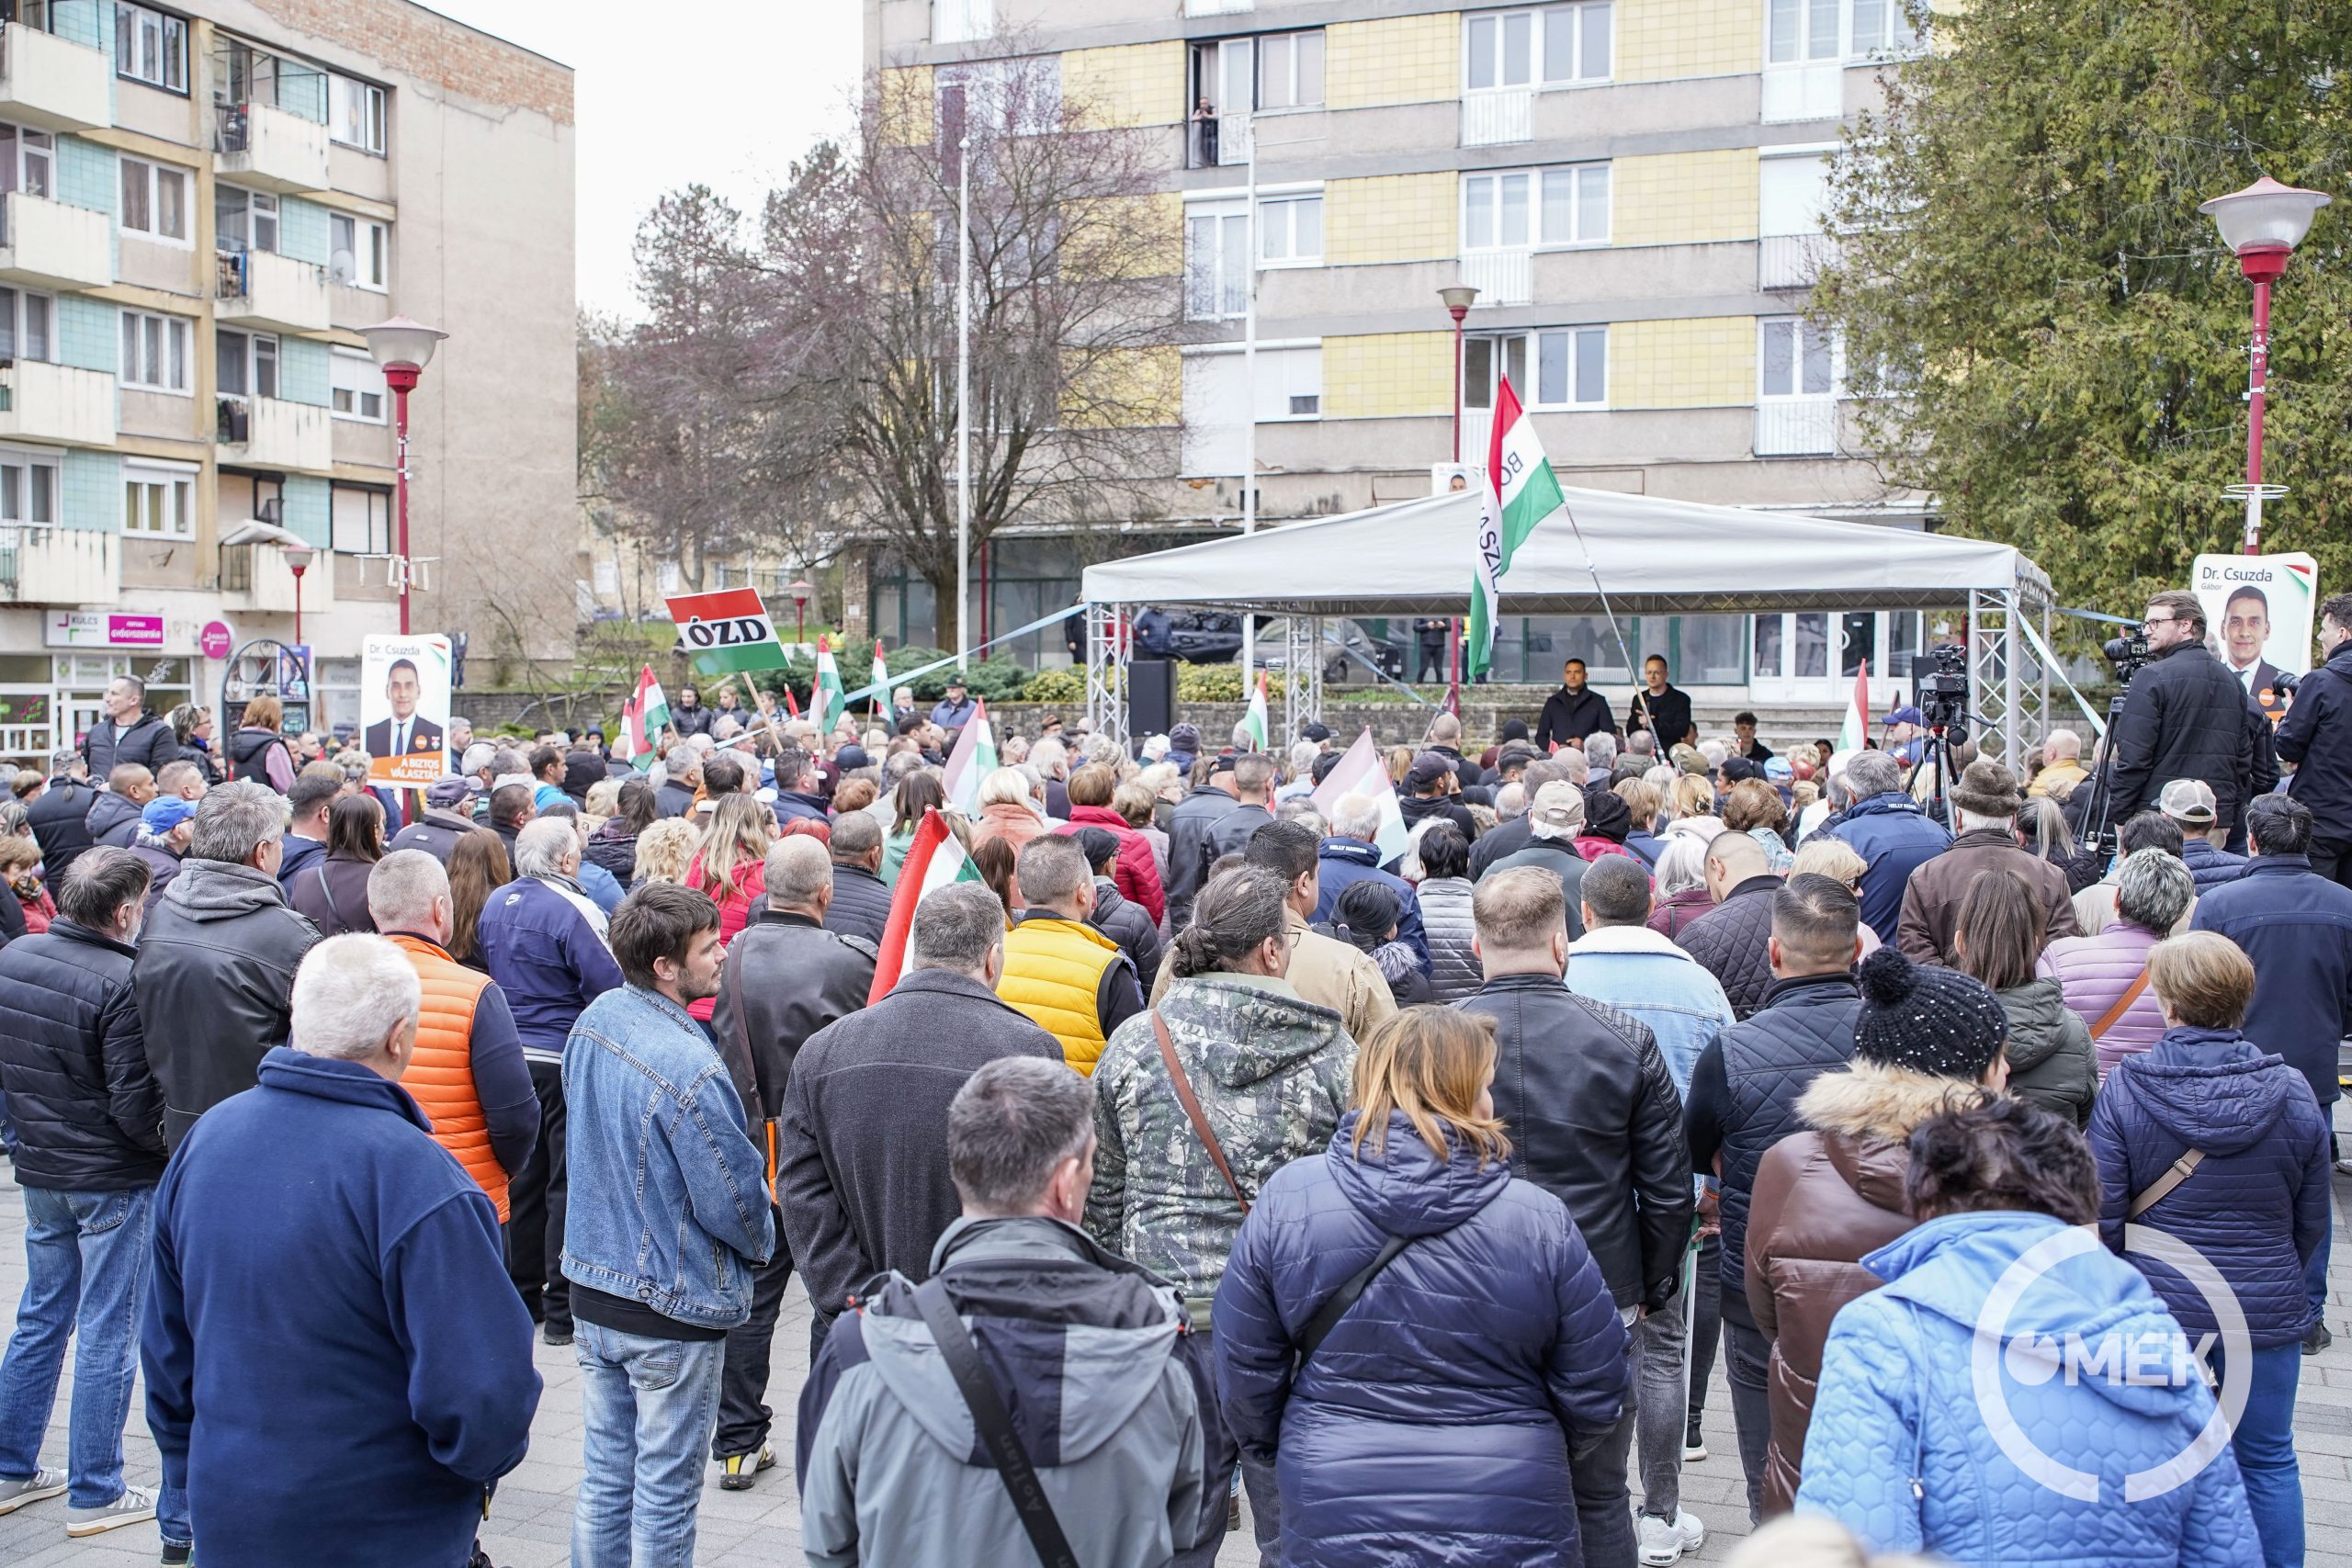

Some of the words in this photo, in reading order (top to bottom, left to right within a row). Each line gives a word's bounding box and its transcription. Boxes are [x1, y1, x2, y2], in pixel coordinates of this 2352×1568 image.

[2202, 566, 2220, 580] Dr.
[2223, 567, 2273, 582] Csuzda
[688, 617, 767, 647] ÓZD
[369, 643, 383, 654] Dr.
[385, 643, 421, 656] Csuzda
[401, 758, 409, 768] A
[409, 758, 440, 770] BIZTOS
